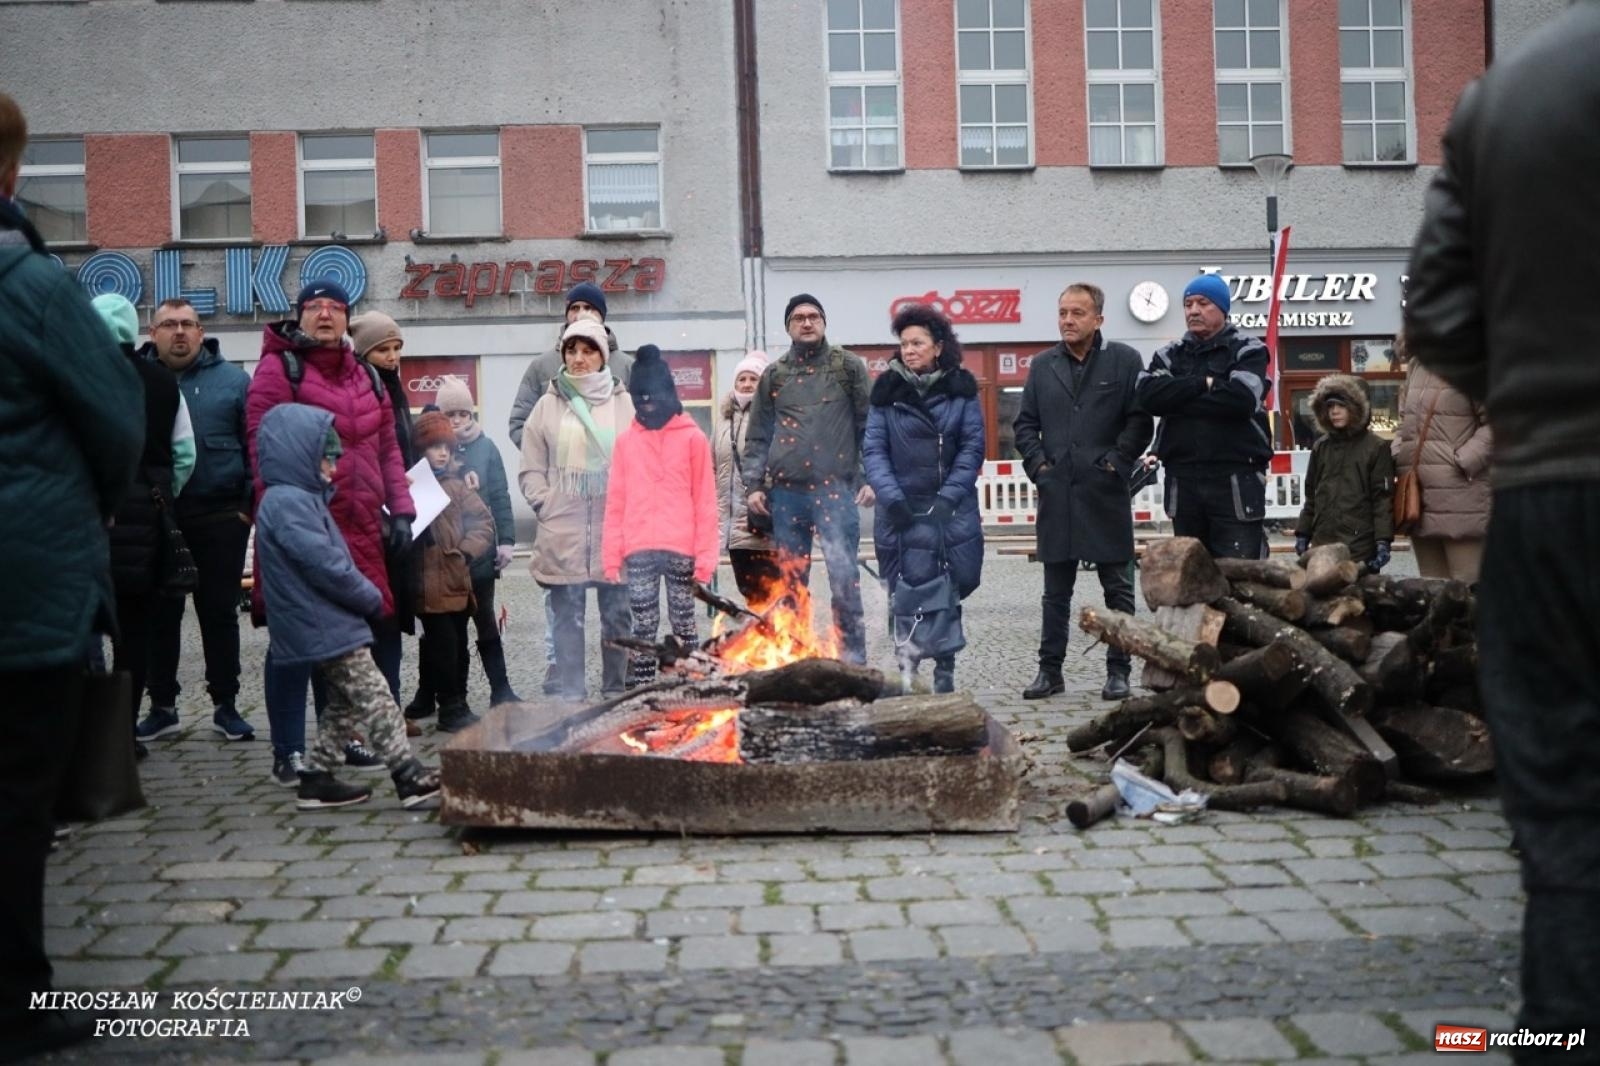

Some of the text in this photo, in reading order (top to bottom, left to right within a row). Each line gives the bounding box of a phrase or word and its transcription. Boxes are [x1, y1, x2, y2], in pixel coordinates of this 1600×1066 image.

[47, 245, 666, 315] OLKO zaprasza
[1200, 267, 1378, 302] UBILER
[1225, 311, 1354, 328] EGAMISTRZ
